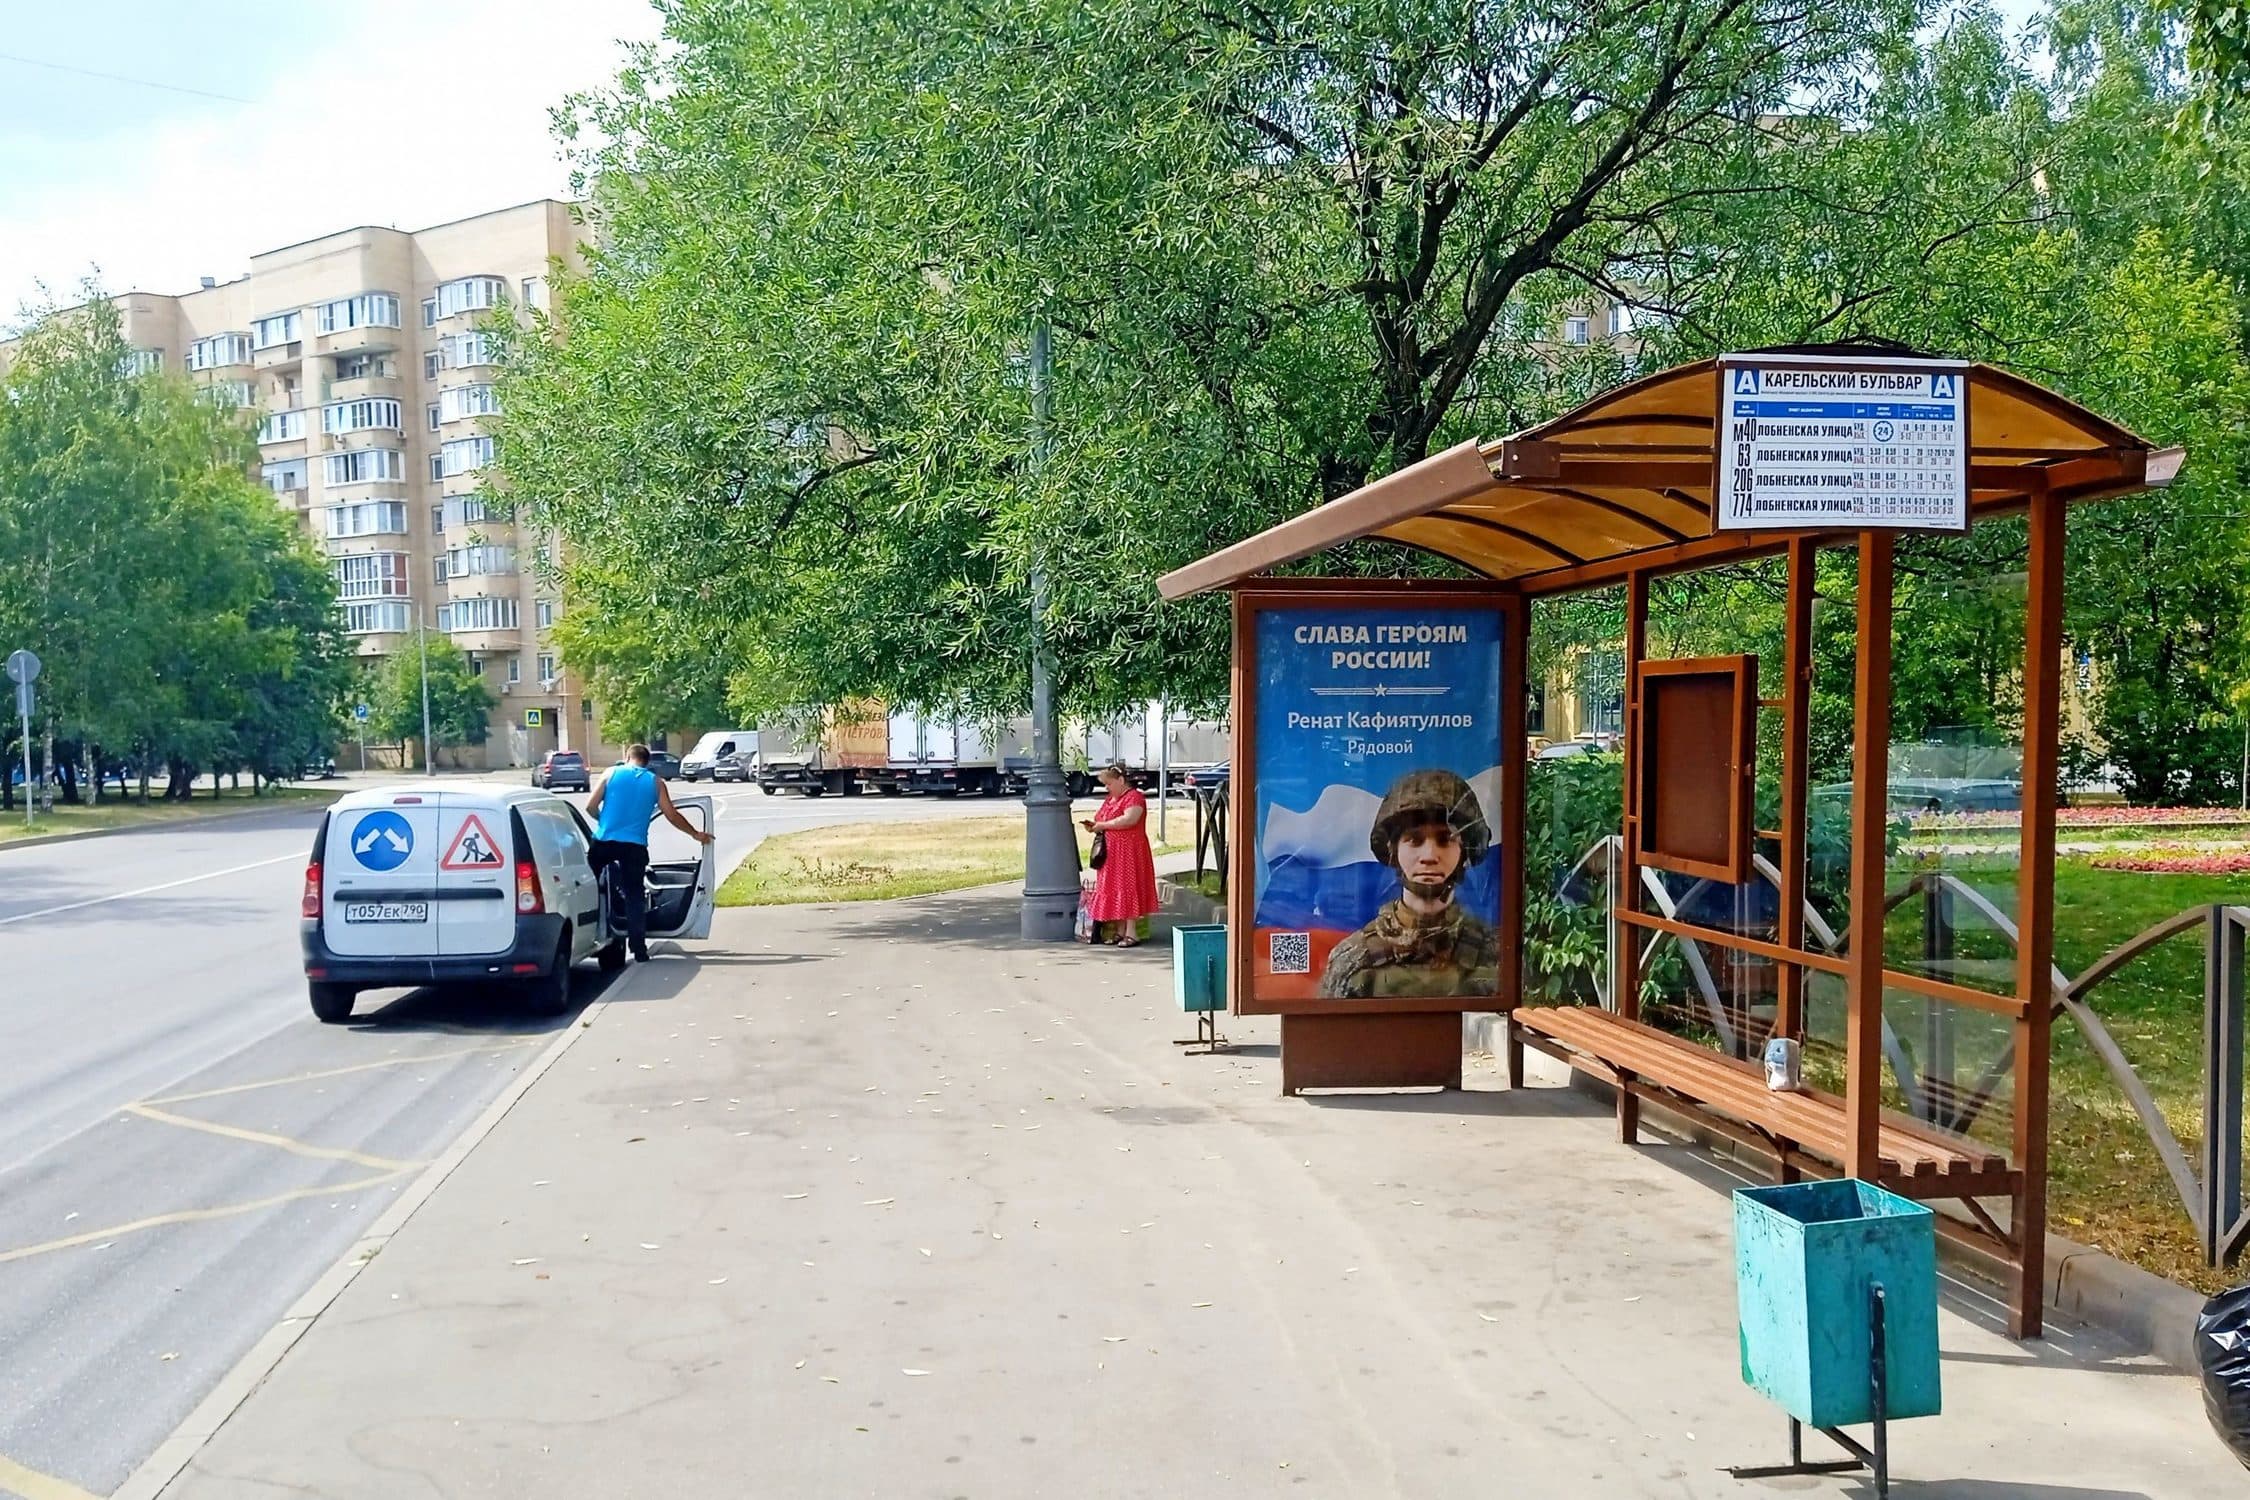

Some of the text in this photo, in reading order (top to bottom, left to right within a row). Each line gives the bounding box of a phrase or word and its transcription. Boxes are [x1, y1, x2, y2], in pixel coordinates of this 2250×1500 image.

[1736, 370, 1954, 397] А КАРЕЛЬСКИЙ БУЛЬВАР А
[1733, 418, 1852, 441] М40 ЛОБНЕНСКАЯ УЛИЦА
[1877, 427, 1888, 436] 24
[1737, 443, 1852, 467] 63 ЛОБНЕНСКАЯ УЛИЦА
[1733, 468, 1852, 492] 206 ЛОБНЕНСКАЯ УЛИЦА
[1732, 493, 1852, 517] 774 ЛОБНЕНСКАЯ УЛИЦА
[1294, 625, 1467, 644] СЛАВА ГЕРОЯМ
[1331, 651, 1431, 669] РОССИИ!
[1288, 711, 1473, 732] Ренат Кафиятуллов
[1348, 739, 1413, 755] Рядовой
